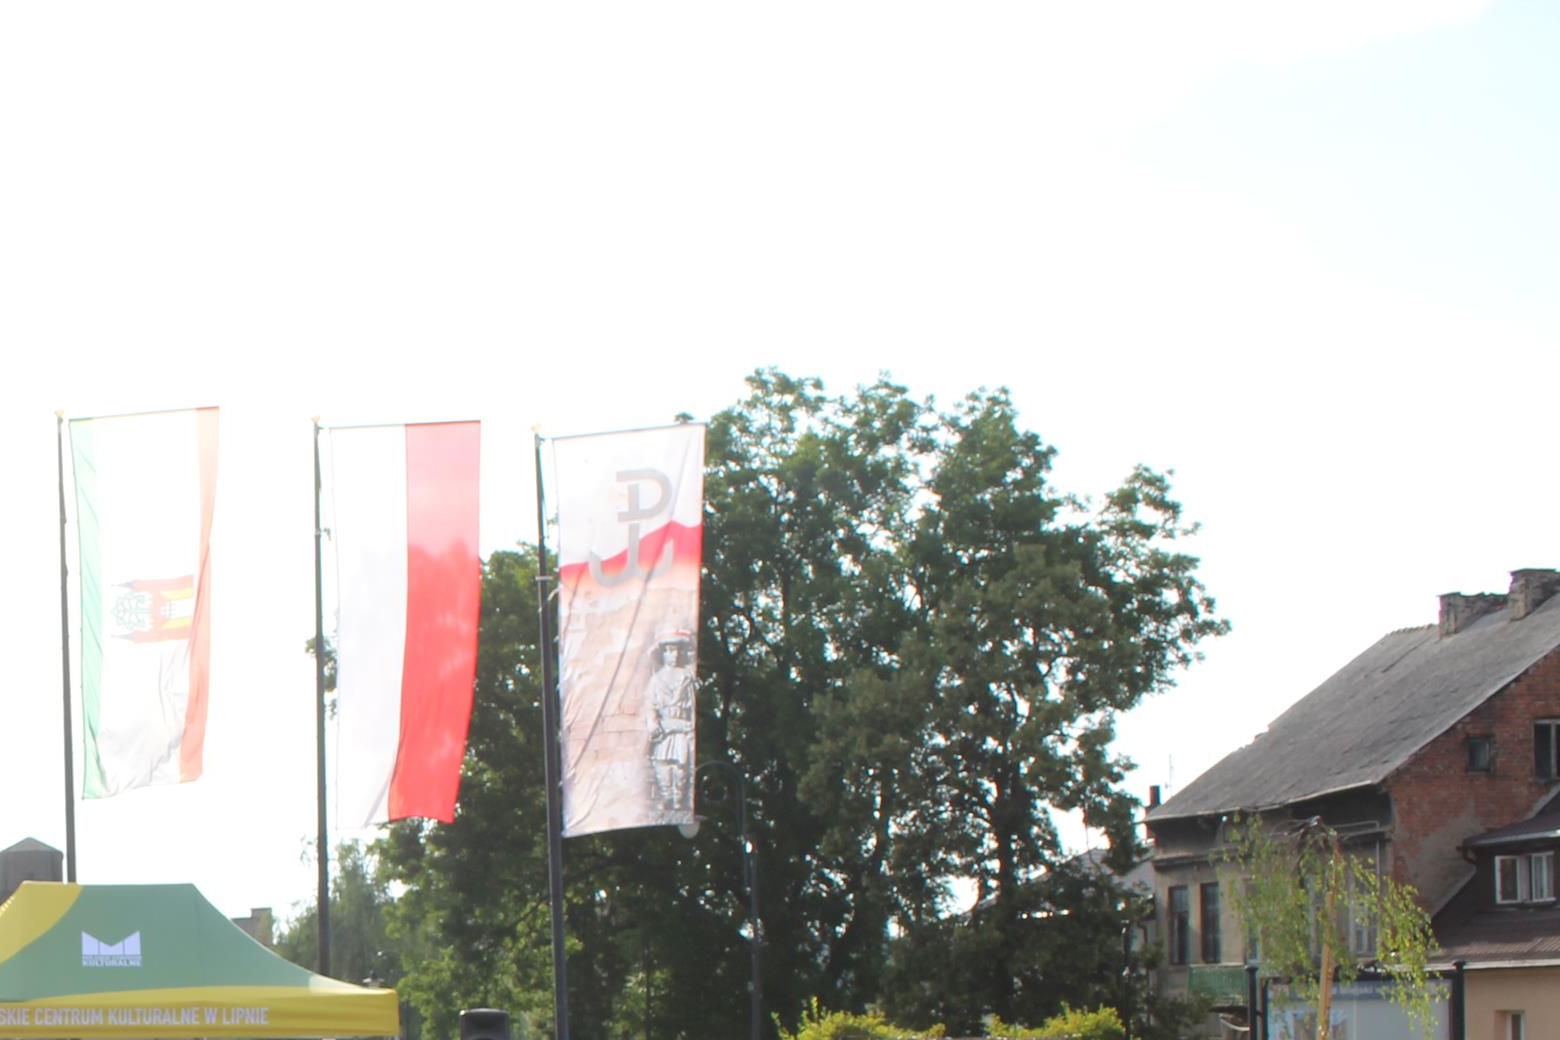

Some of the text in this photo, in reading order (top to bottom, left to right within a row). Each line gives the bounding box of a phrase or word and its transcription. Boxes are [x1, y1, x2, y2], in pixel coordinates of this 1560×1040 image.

[34, 1007, 104, 1025] CENTRUM
[107, 1007, 200, 1025] KULTURALNE
[204, 1007, 218, 1025] W
[222, 1007, 269, 1025] LIPNIE
